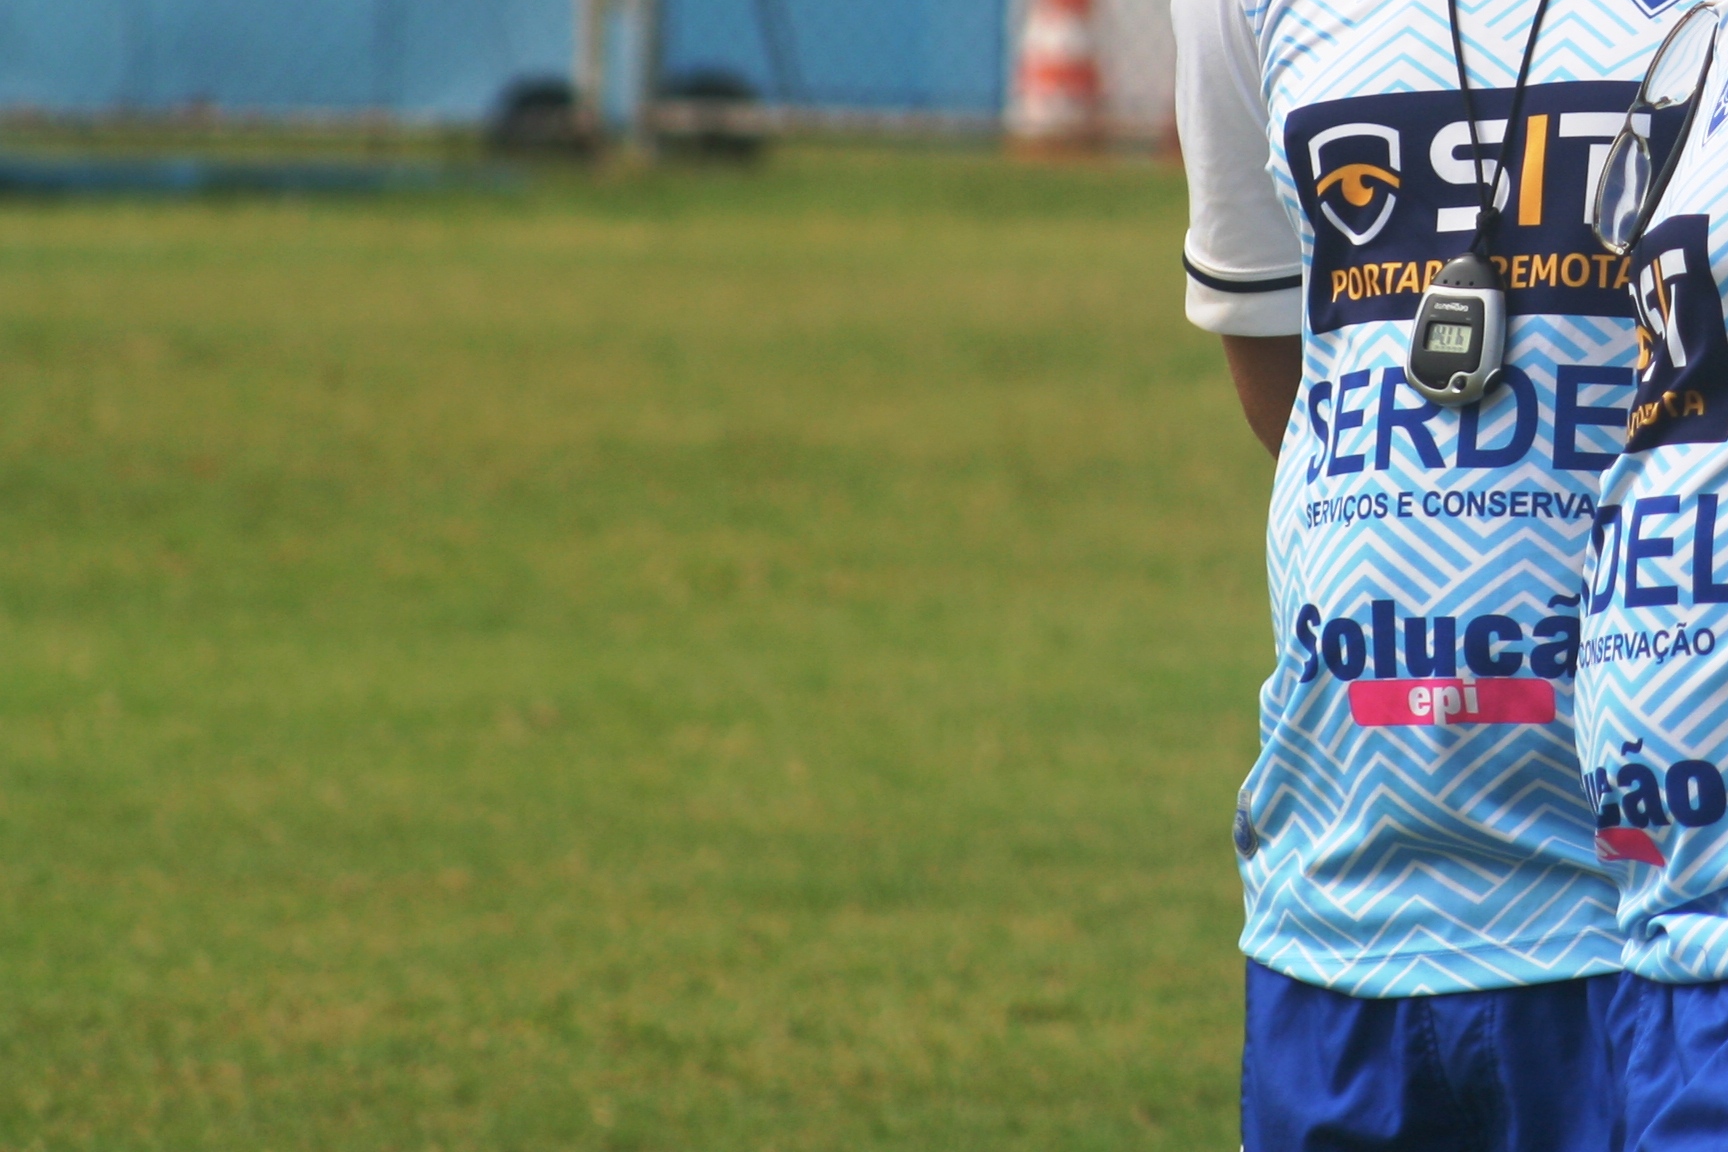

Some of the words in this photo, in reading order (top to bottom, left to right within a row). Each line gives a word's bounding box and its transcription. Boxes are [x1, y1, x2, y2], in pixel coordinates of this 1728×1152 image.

[1429, 112, 1651, 233] SIT
[1306, 493, 1388, 529] SERVIÇOS
[1397, 492, 1413, 517] E
[1422, 491, 1596, 518] CONSERVA
[1579, 622, 1716, 668] CONSERVAÇÃO
[1408, 678, 1479, 725] epi
